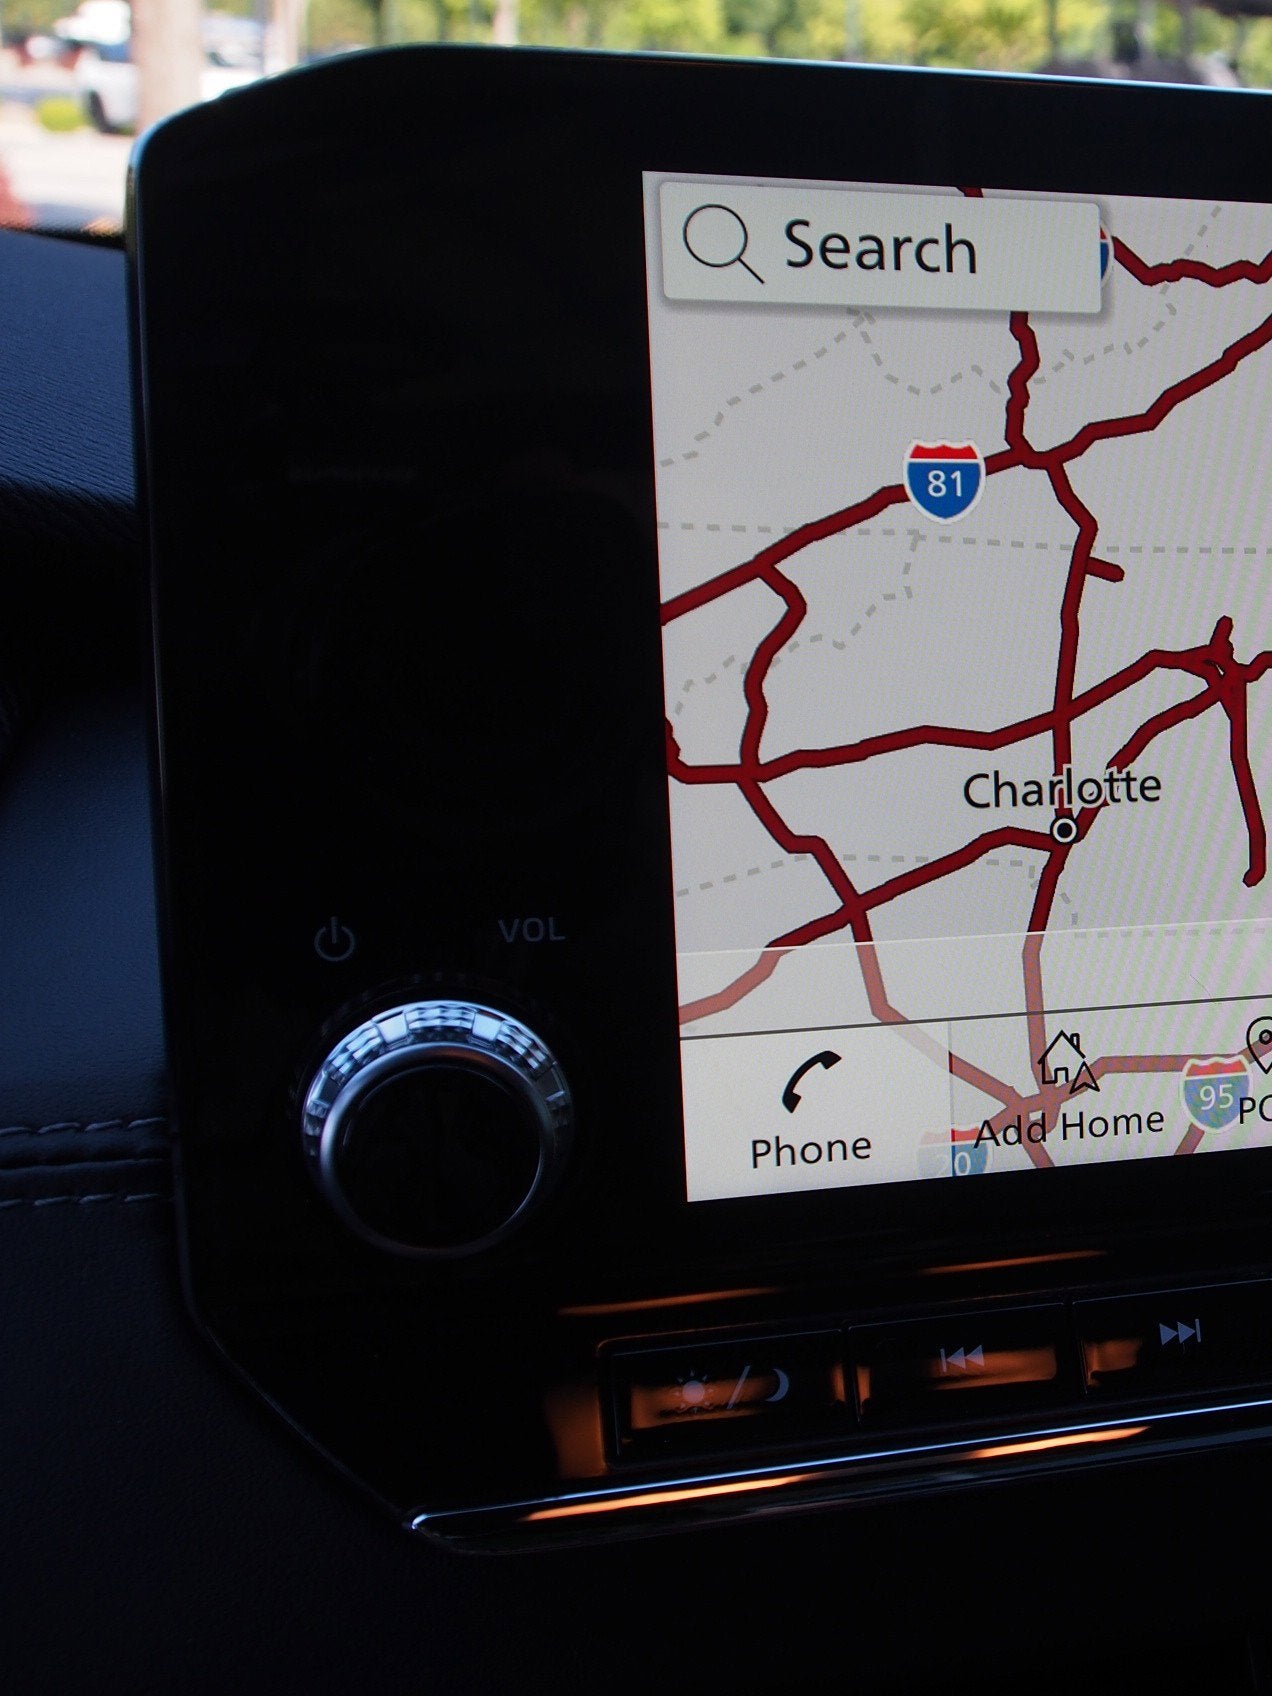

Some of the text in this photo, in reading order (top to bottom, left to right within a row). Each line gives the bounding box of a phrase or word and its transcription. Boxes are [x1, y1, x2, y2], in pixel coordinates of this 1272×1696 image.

[783, 217, 978, 274] Search
[926, 469, 965, 499] 81
[962, 766, 1163, 809] Charlotte
[497, 916, 567, 943] VOL
[1199, 1083, 1234, 1110] 95
[973, 1107, 1165, 1149] Add Home
[751, 1133, 872, 1169] Phone
